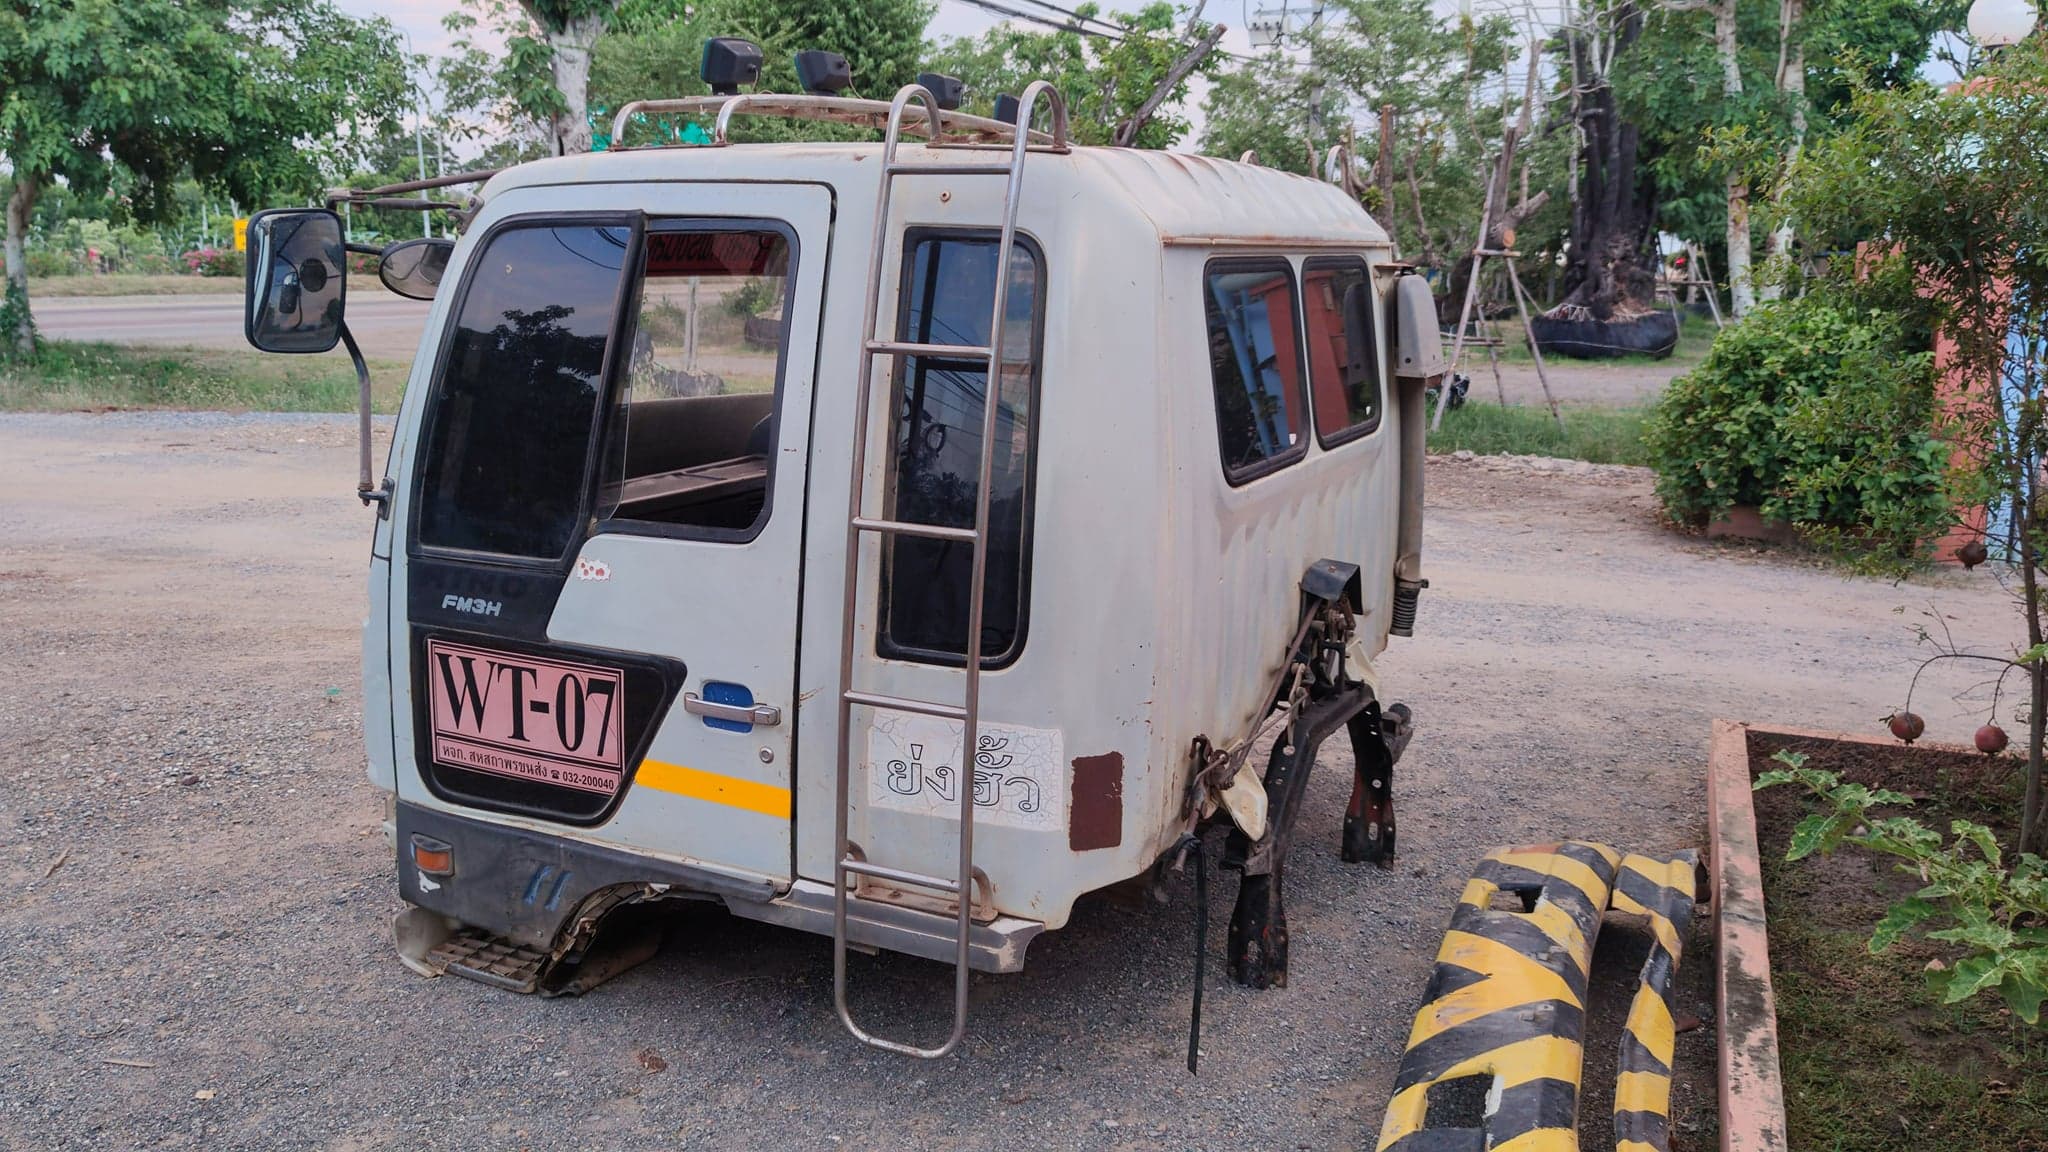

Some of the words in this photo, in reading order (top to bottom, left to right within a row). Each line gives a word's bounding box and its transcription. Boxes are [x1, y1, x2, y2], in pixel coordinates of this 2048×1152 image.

[442, 594, 502, 617] FM3H
[434, 652, 617, 757] WT-07
[442, 744, 467, 762] หจก.
[562, 772, 614, 791] 032-200040
